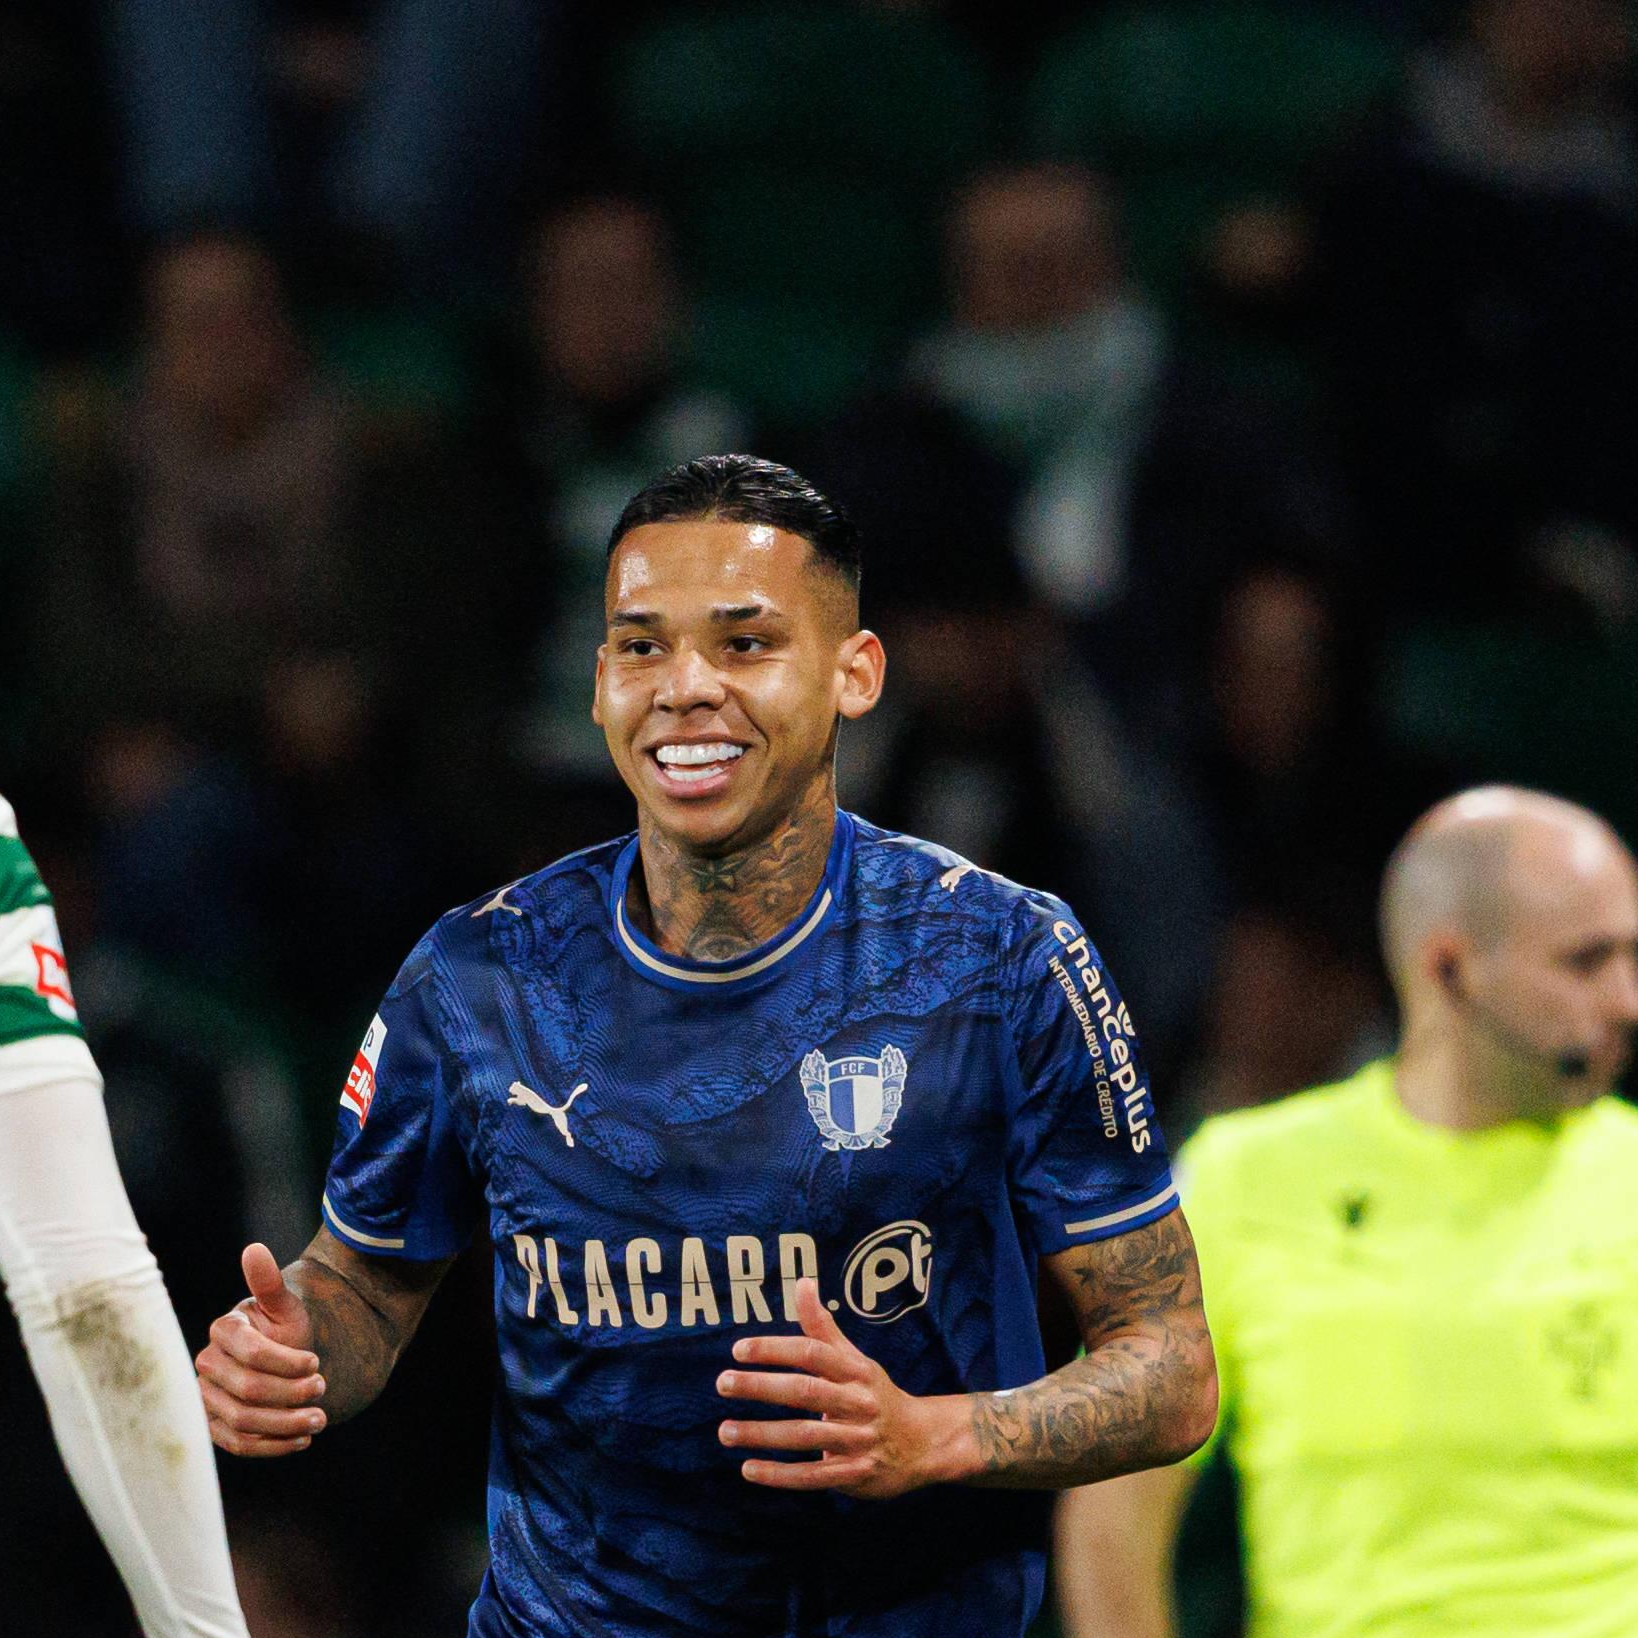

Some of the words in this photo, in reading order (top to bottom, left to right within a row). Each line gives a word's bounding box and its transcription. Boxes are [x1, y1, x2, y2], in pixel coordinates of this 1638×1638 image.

[1048, 955, 1102, 1059] INTERMEDIÁRIO
[1052, 919, 1152, 1154] chanceplus
[840, 1062, 866, 1076] FCF
[1093, 1059, 1107, 1078] DE
[1095, 1080, 1118, 1139] CRÉDITO
